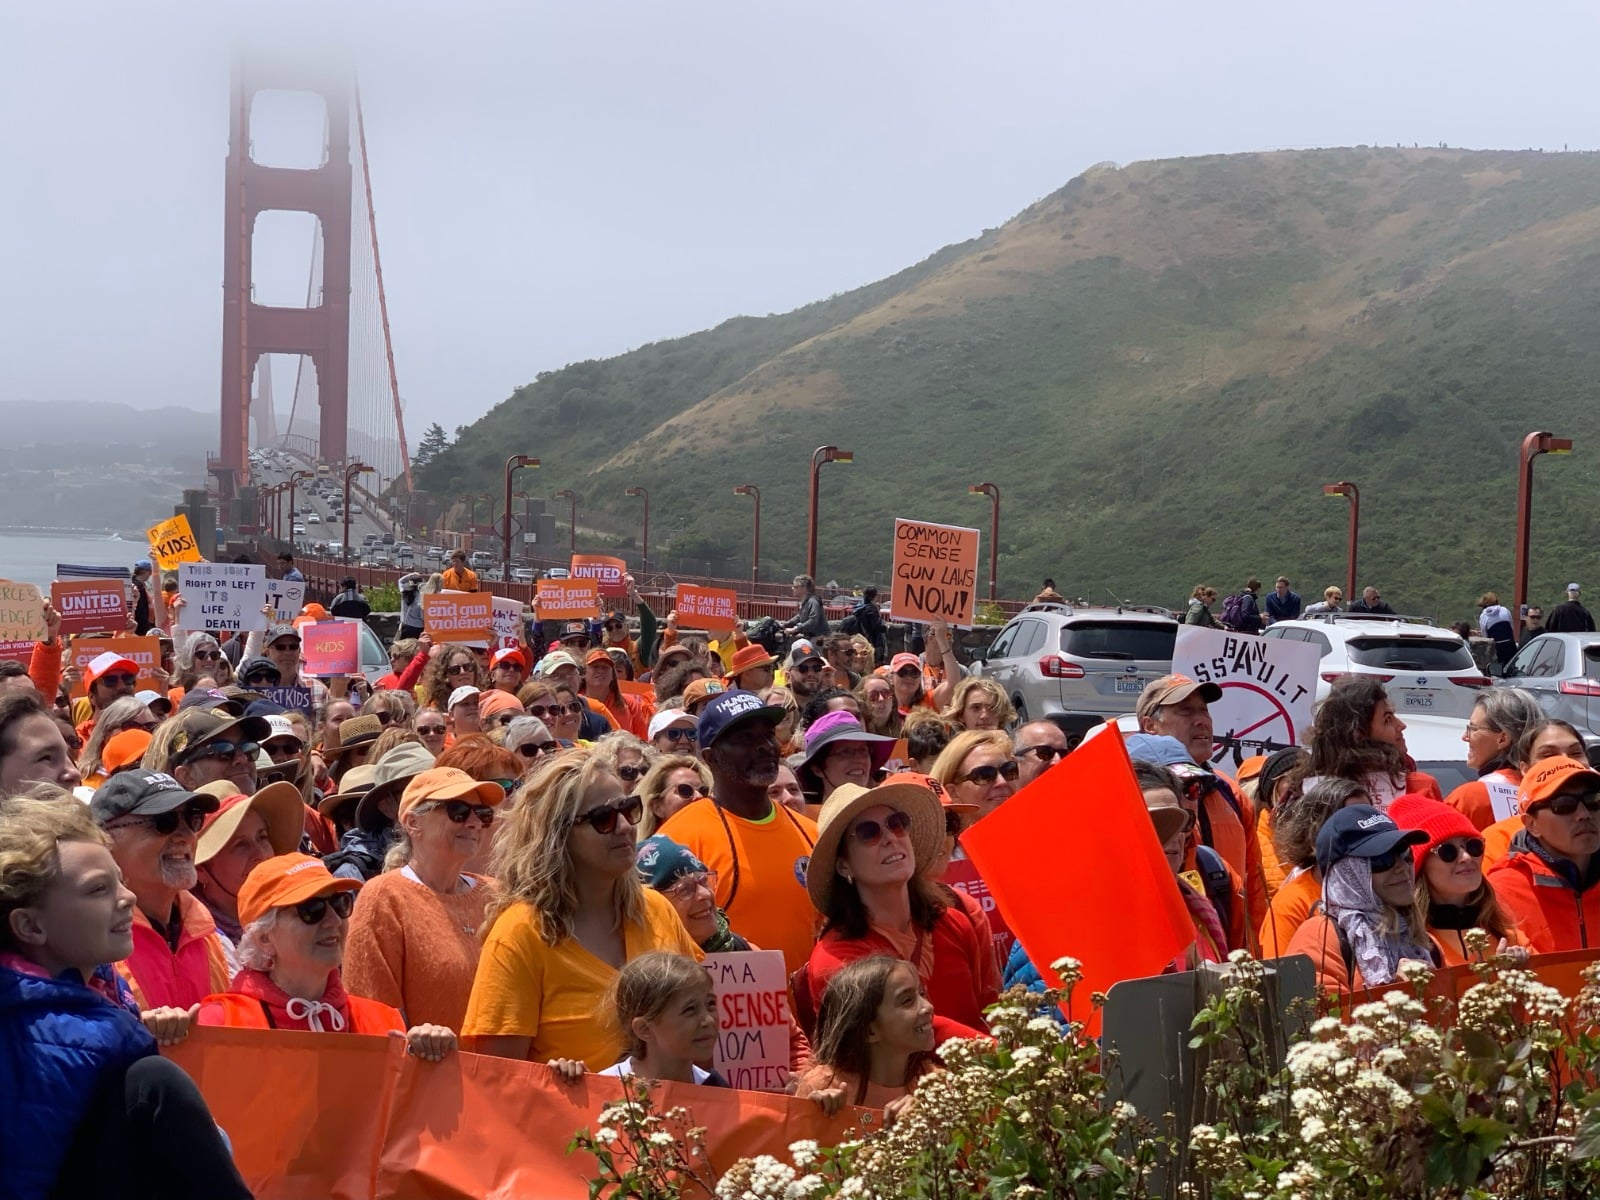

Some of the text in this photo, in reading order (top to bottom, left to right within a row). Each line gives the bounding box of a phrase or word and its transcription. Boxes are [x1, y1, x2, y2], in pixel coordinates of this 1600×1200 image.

[897, 524, 961, 545] COMMON
[157, 535, 196, 557] KIDS!
[904, 543, 961, 562] SENSE
[188, 566, 212, 575] THIS
[574, 566, 620, 579] UNITED
[897, 563, 974, 587] GUN LAWS
[185, 579, 256, 590] RIGHT OR LEFT
[268, 582, 277, 591] IS
[0, 587, 37, 602] RCE'S
[265, 593, 283, 609] T
[540, 587, 592, 600] end gun
[683, 593, 731, 608] WE CAN END
[905, 584, 968, 618] NOW!
[62, 594, 121, 610] UNITED
[201, 605, 224, 614] LIFE
[428, 602, 487, 618] end gun
[541, 599, 595, 609] violence
[678, 602, 735, 618] GUN VIOLENCE
[206, 619, 240, 629] DEATH
[428, 617, 492, 630] violence
[316, 641, 345, 653] KIDS
[1223, 637, 1267, 668] BAN
[1193, 640, 1308, 704] SSAULT
[286, 687, 310, 708] KIDS
[742, 962, 756, 984] A
[721, 990, 788, 1030] SENSE
[727, 1066, 788, 1091] VOTES
